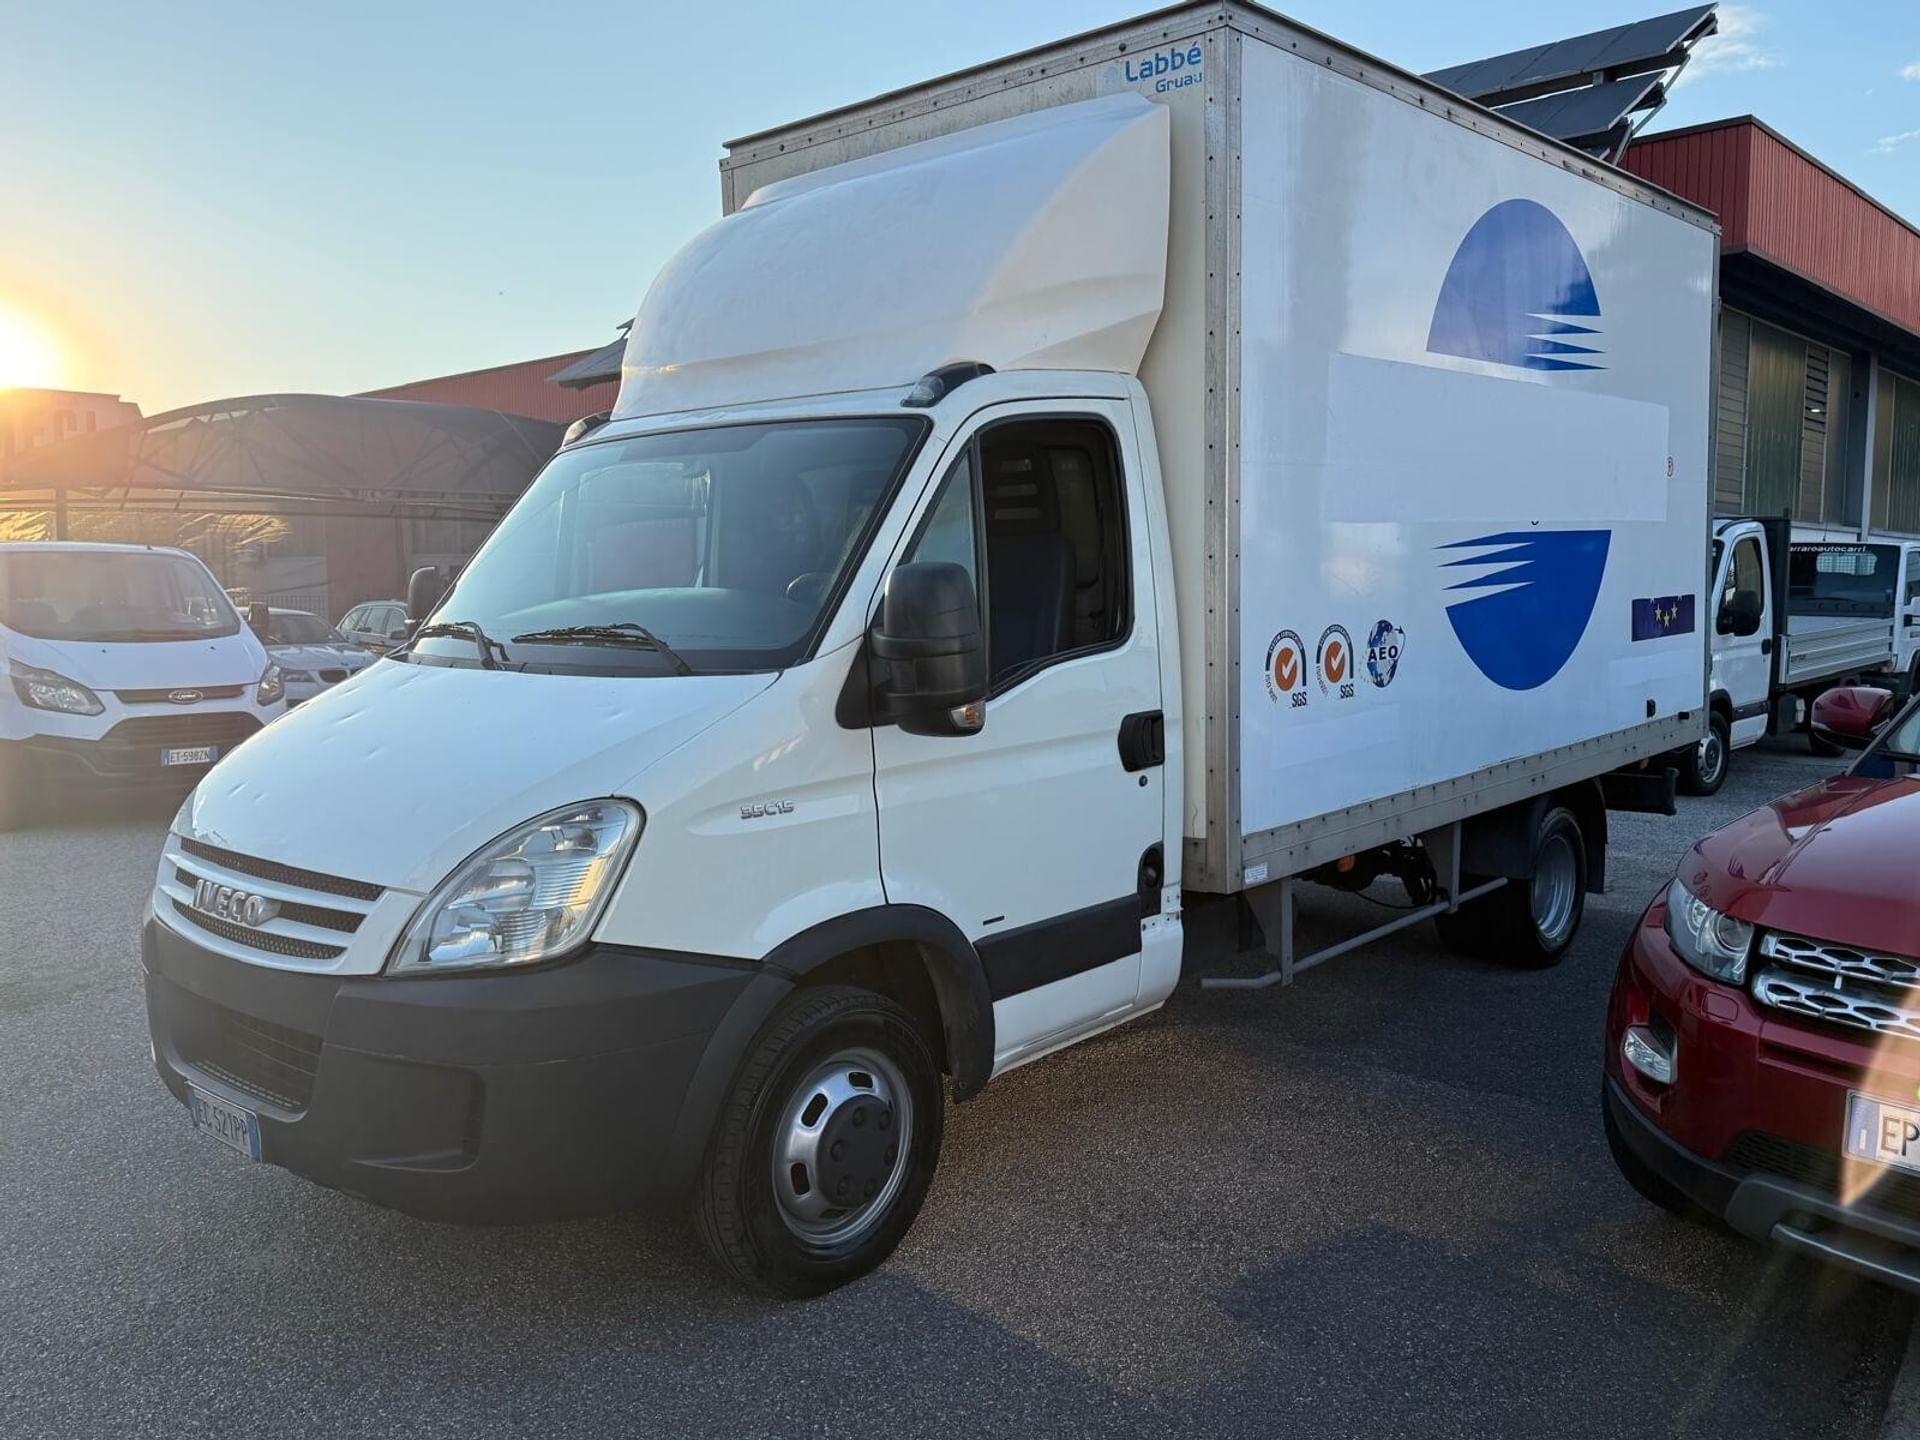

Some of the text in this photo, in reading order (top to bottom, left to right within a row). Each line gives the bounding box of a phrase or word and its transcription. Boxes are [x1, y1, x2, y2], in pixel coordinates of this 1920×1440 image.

[1125, 41, 1202, 82] Labbé
[1368, 645, 1399, 661] AEO
[1291, 691, 1307, 708] SGS
[1340, 683, 1354, 699] SGS
[740, 800, 795, 820] 35C15
[193, 879, 267, 927] IVECO
[1880, 1116, 1920, 1157] EP
